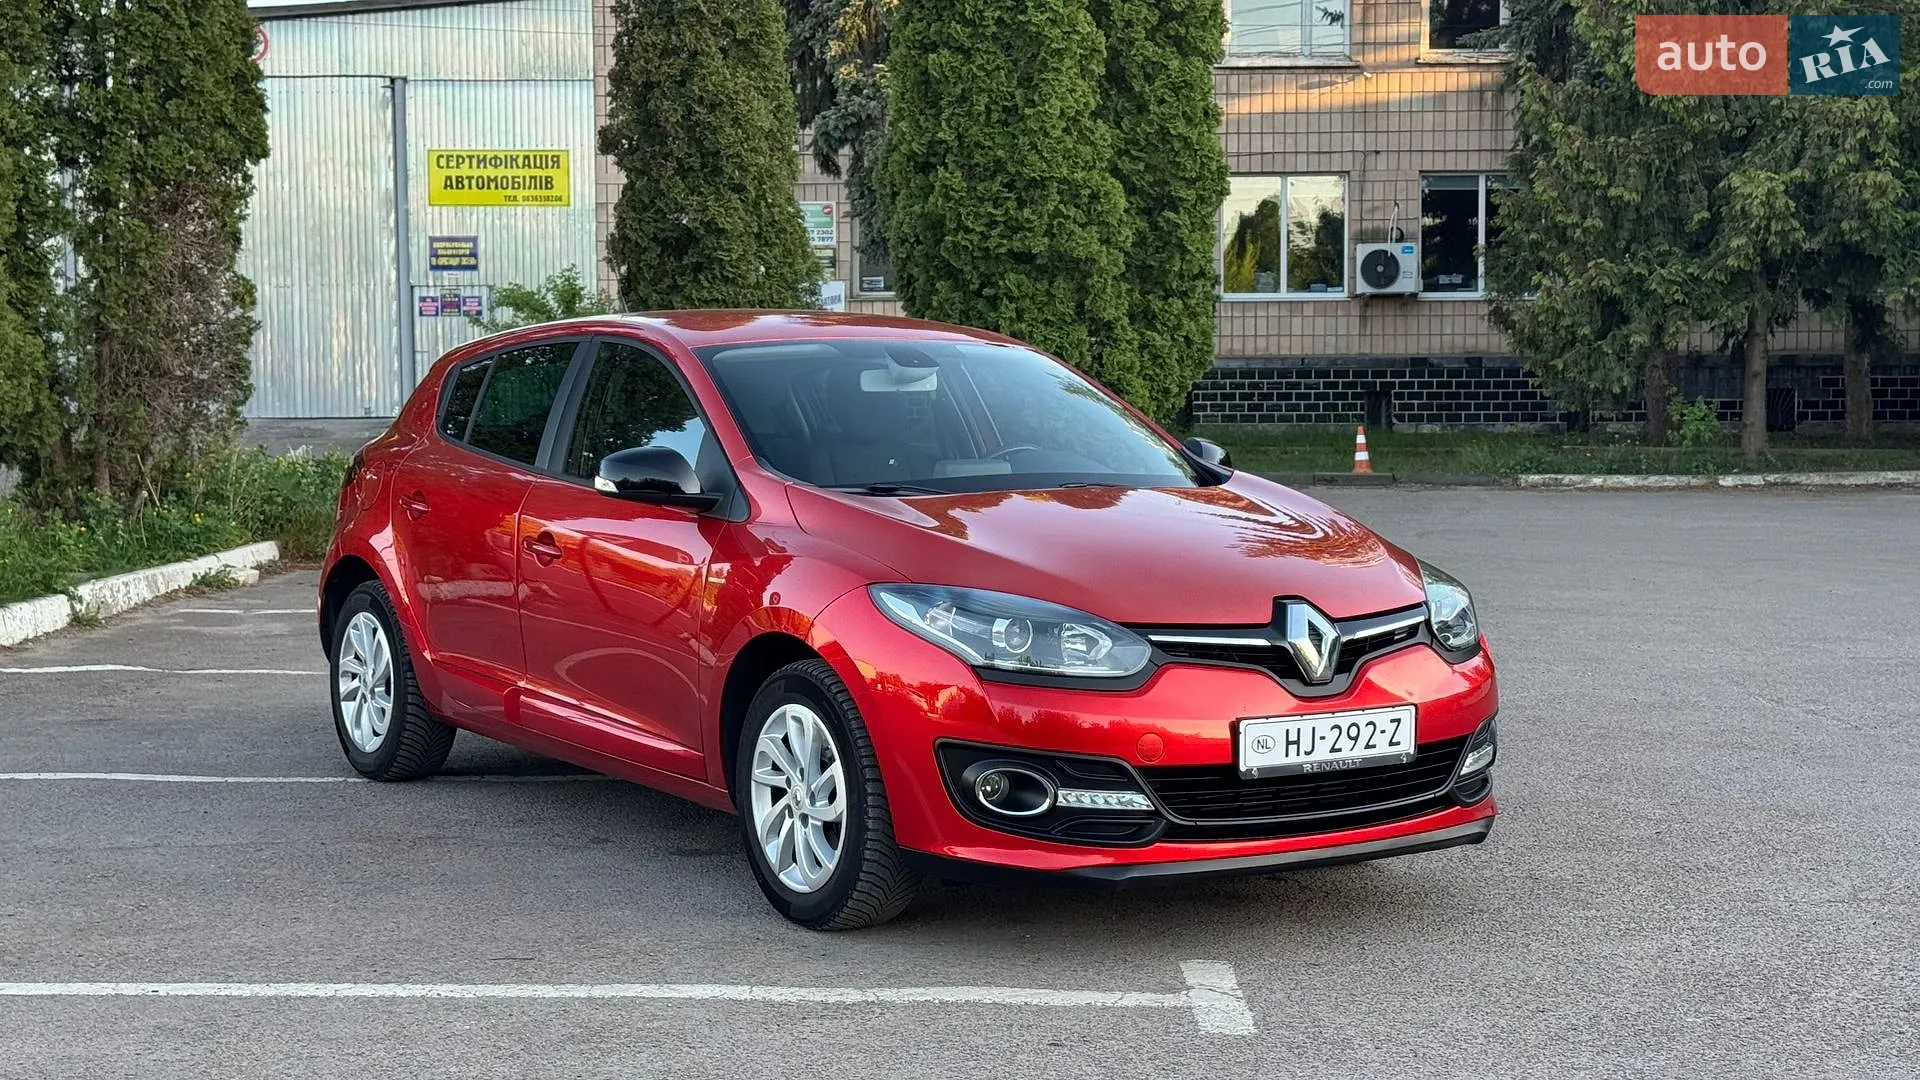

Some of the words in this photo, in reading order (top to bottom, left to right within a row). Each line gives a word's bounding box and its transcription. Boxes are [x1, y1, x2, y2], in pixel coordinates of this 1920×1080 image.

[436, 154, 561, 171] СЕРТИФІКАЦІЯ
[443, 175, 555, 190] АВТОМОБІЛІВ
[1256, 739, 1271, 750] NL
[1285, 718, 1402, 758] HJ-292-Z
[1302, 758, 1363, 773] RENAULT
